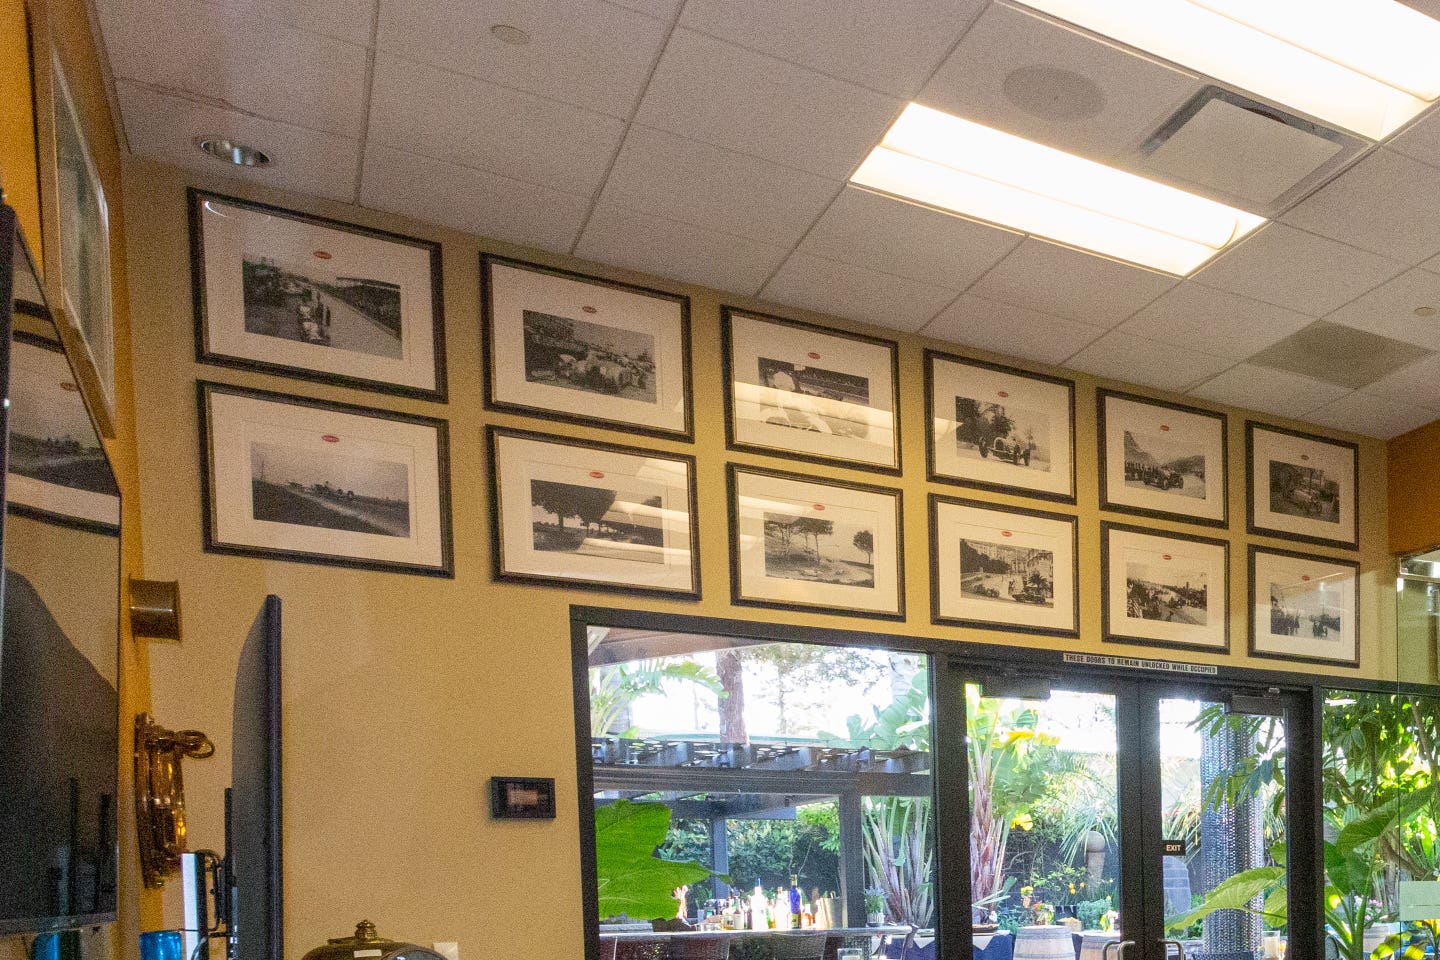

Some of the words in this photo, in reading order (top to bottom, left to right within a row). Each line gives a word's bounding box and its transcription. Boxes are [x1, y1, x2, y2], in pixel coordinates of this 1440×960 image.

[1065, 654, 1084, 662] THESE
[1086, 656, 1106, 665] DOORS
[1117, 658, 1139, 667] REMAIN
[1141, 661, 1170, 670] UNLOCKED
[1172, 664, 1189, 672] WHILE
[1190, 665, 1216, 674] OCCUPIED
[1166, 844, 1182, 852] EXIT
